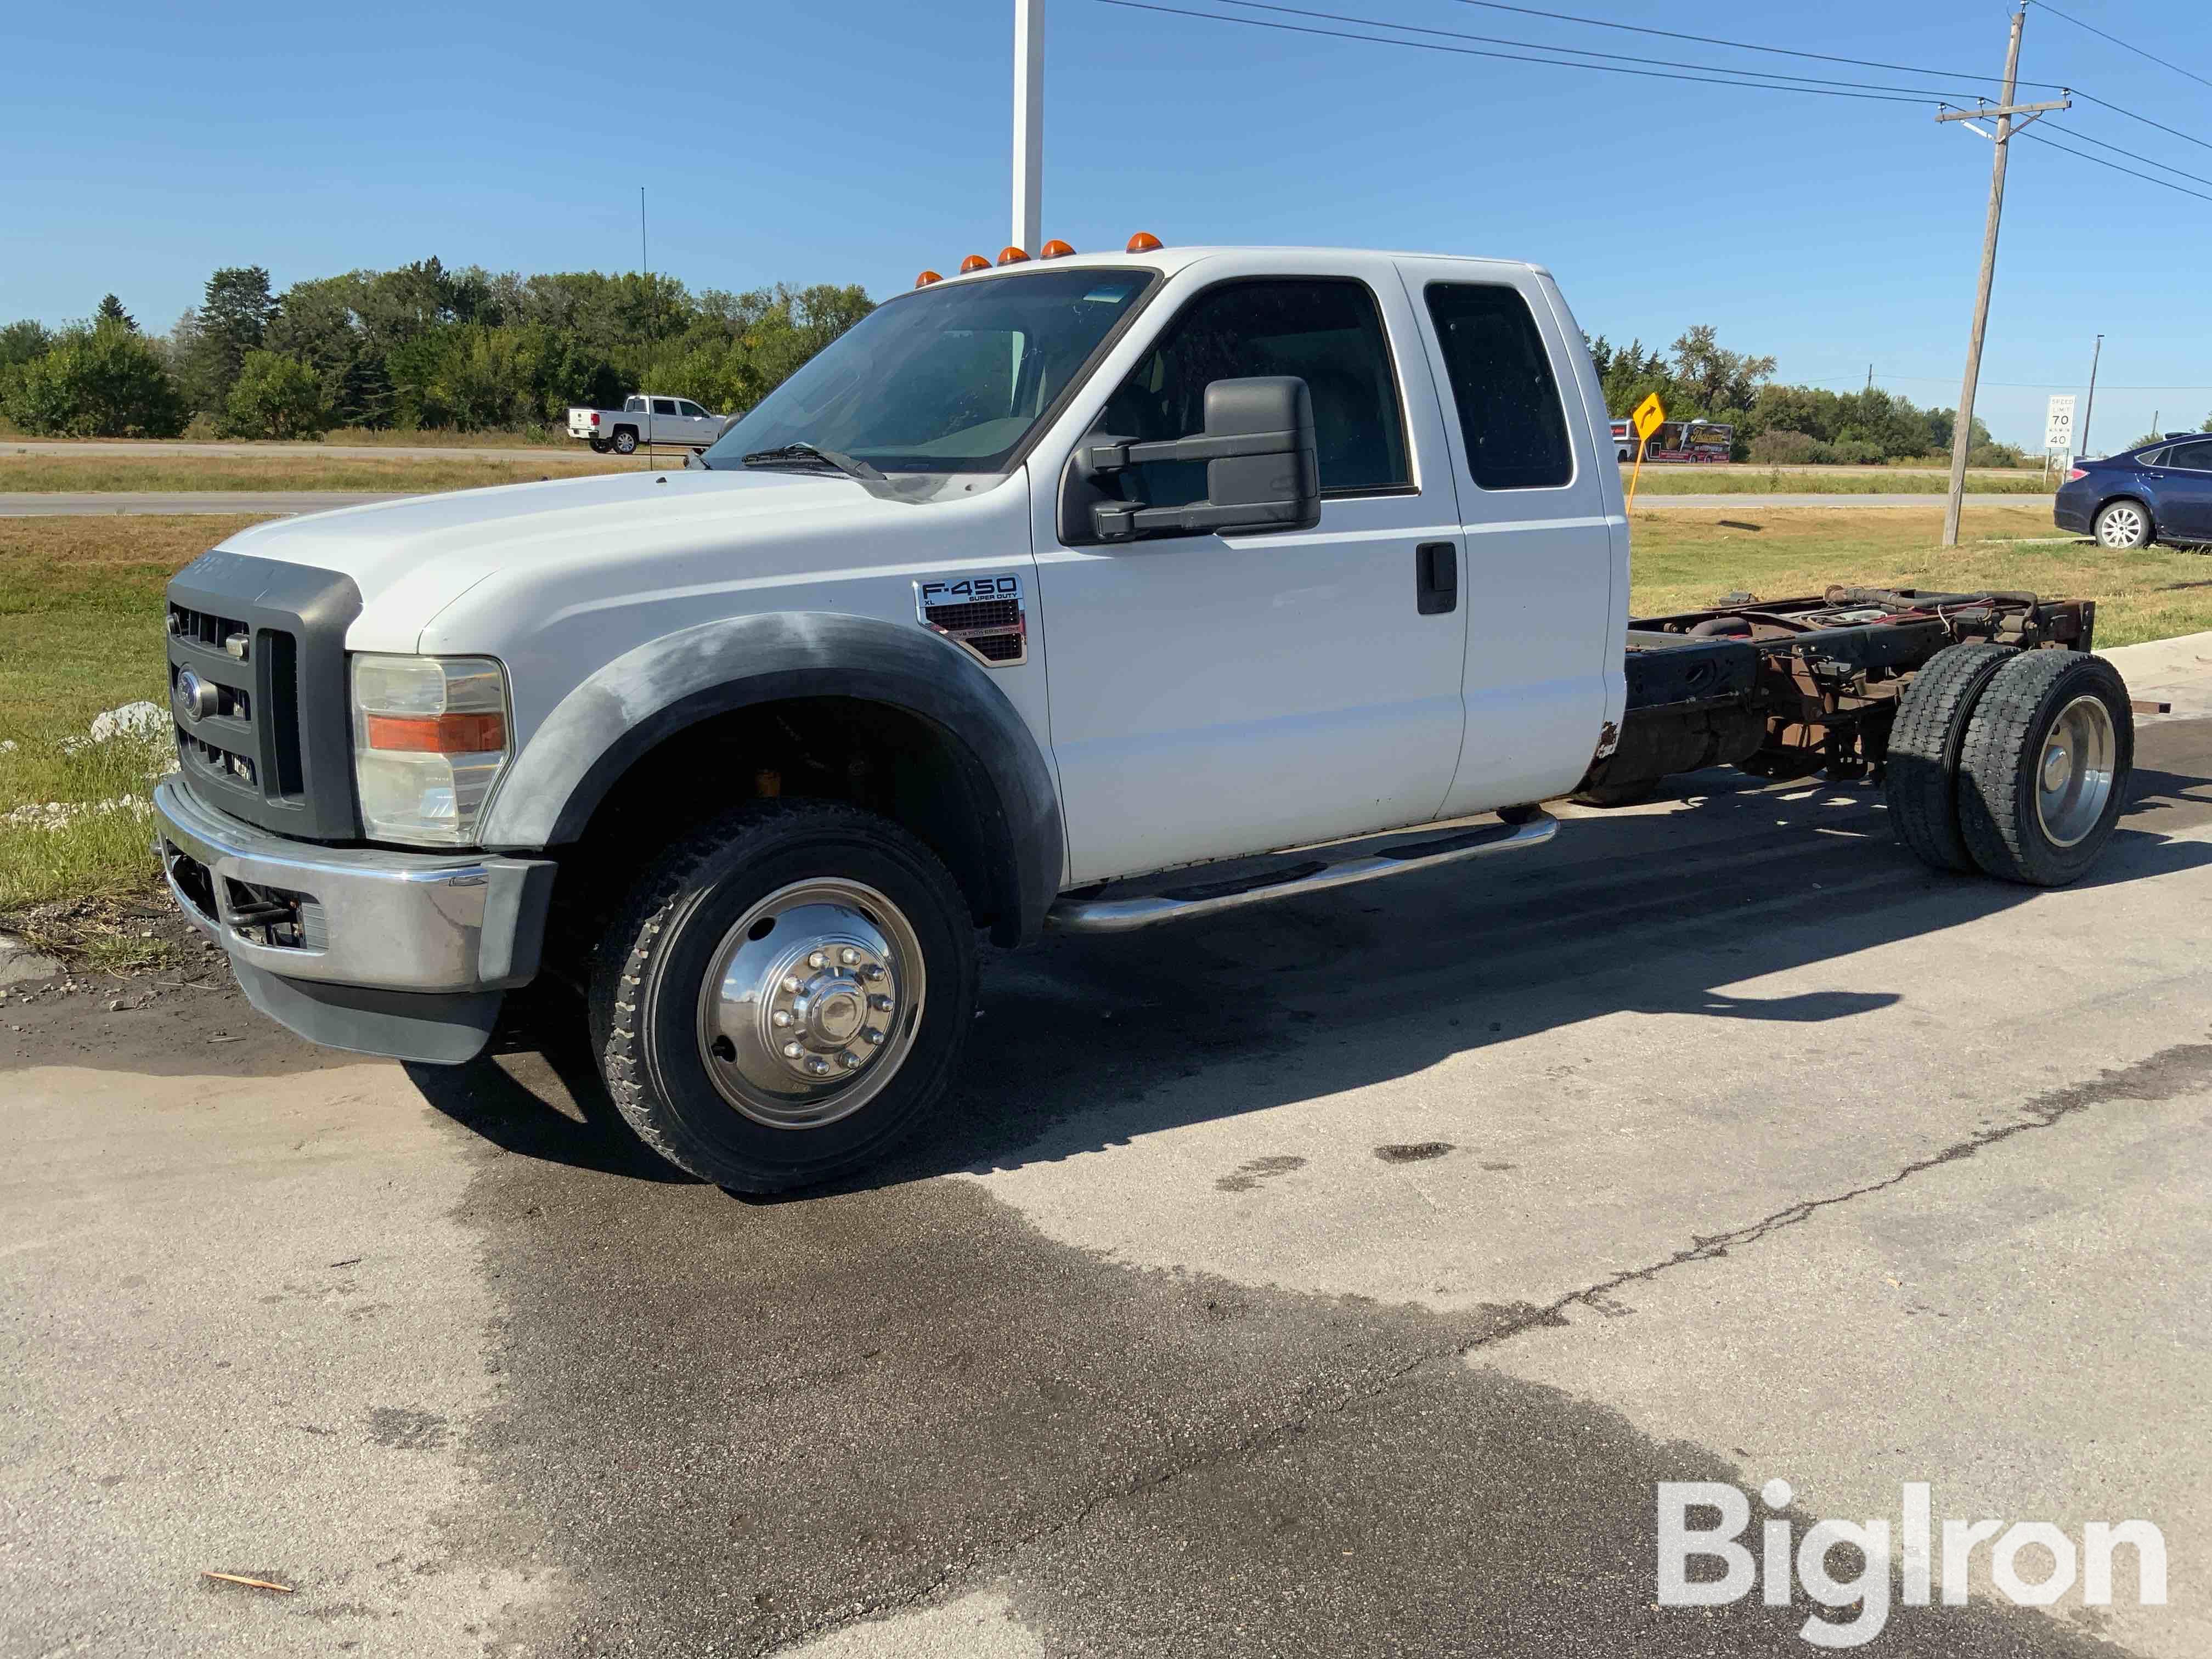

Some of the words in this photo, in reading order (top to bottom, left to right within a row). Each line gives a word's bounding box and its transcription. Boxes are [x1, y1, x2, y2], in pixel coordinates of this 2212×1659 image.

[2052, 415, 2069, 425] 70
[2050, 436, 2066, 444] 40
[922, 577, 1017, 599] F-450
